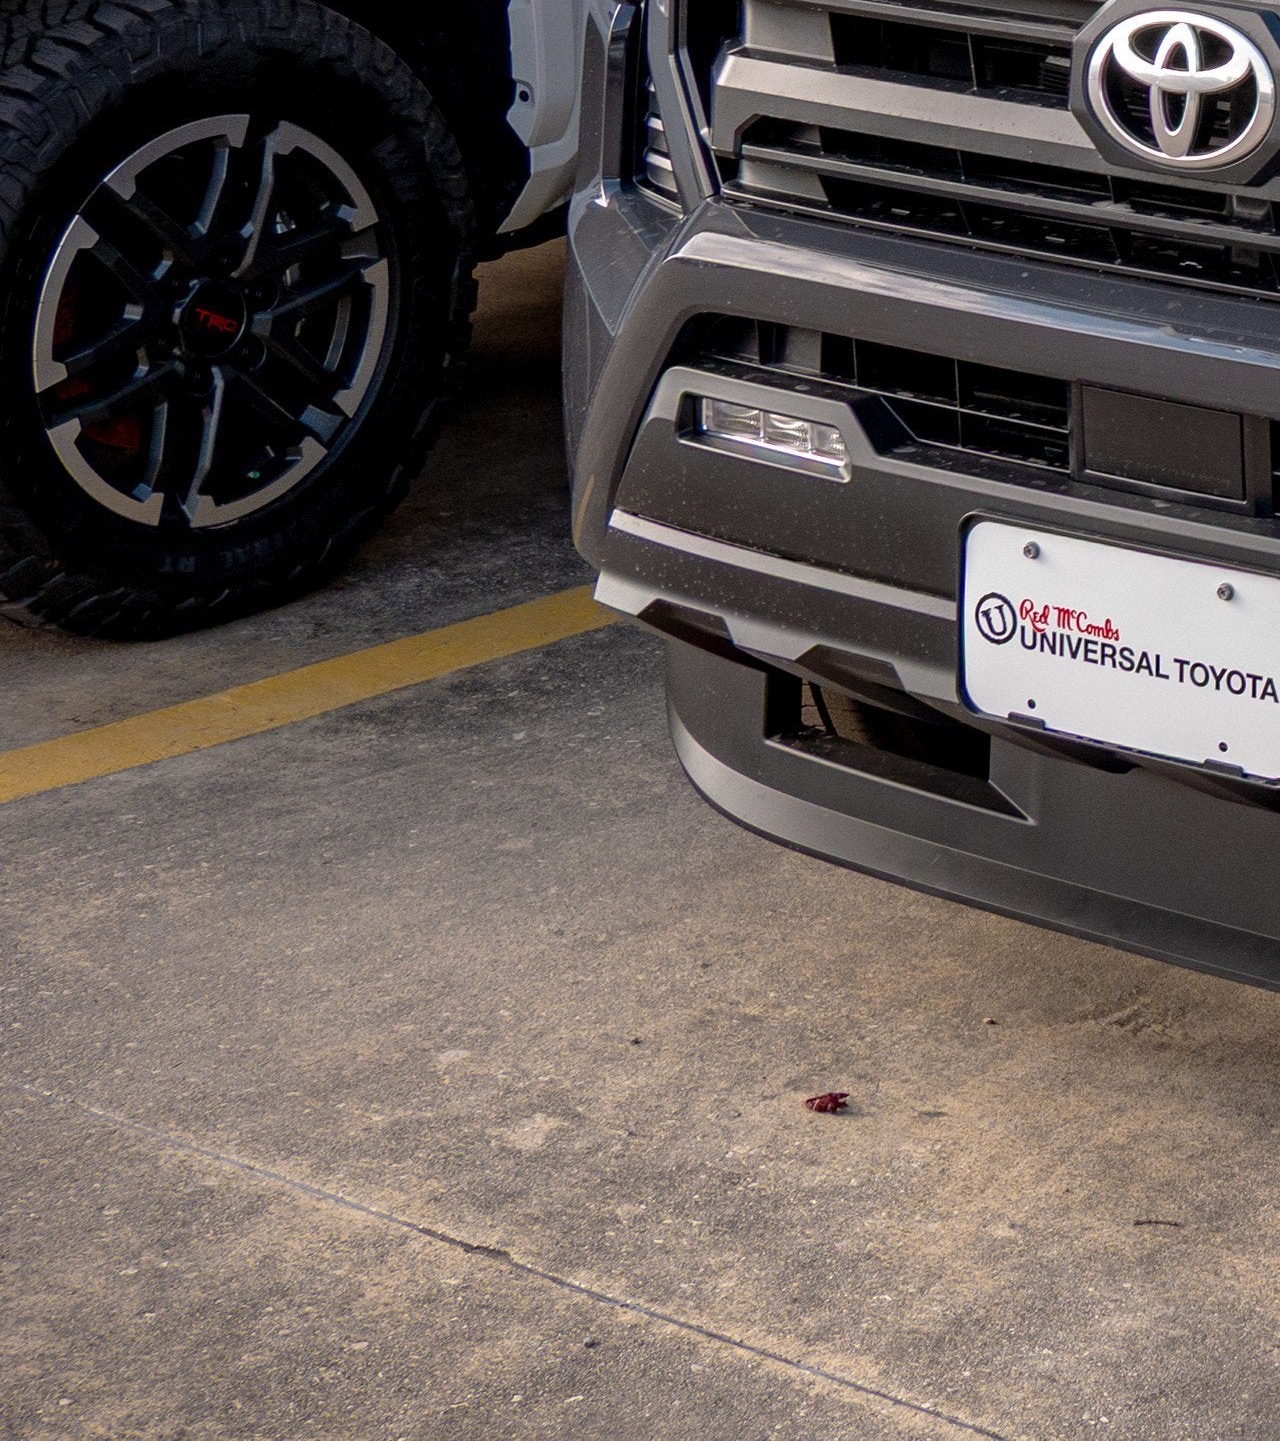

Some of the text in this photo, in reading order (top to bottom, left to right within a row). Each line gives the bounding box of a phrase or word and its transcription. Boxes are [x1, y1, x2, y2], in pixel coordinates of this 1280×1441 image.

[195, 307, 239, 333] TRD
[1019, 599, 1120, 641] Red McCombs
[1019, 624, 1170, 680] UNIVERSAL
[1173, 657, 1280, 704] TOYOTA
